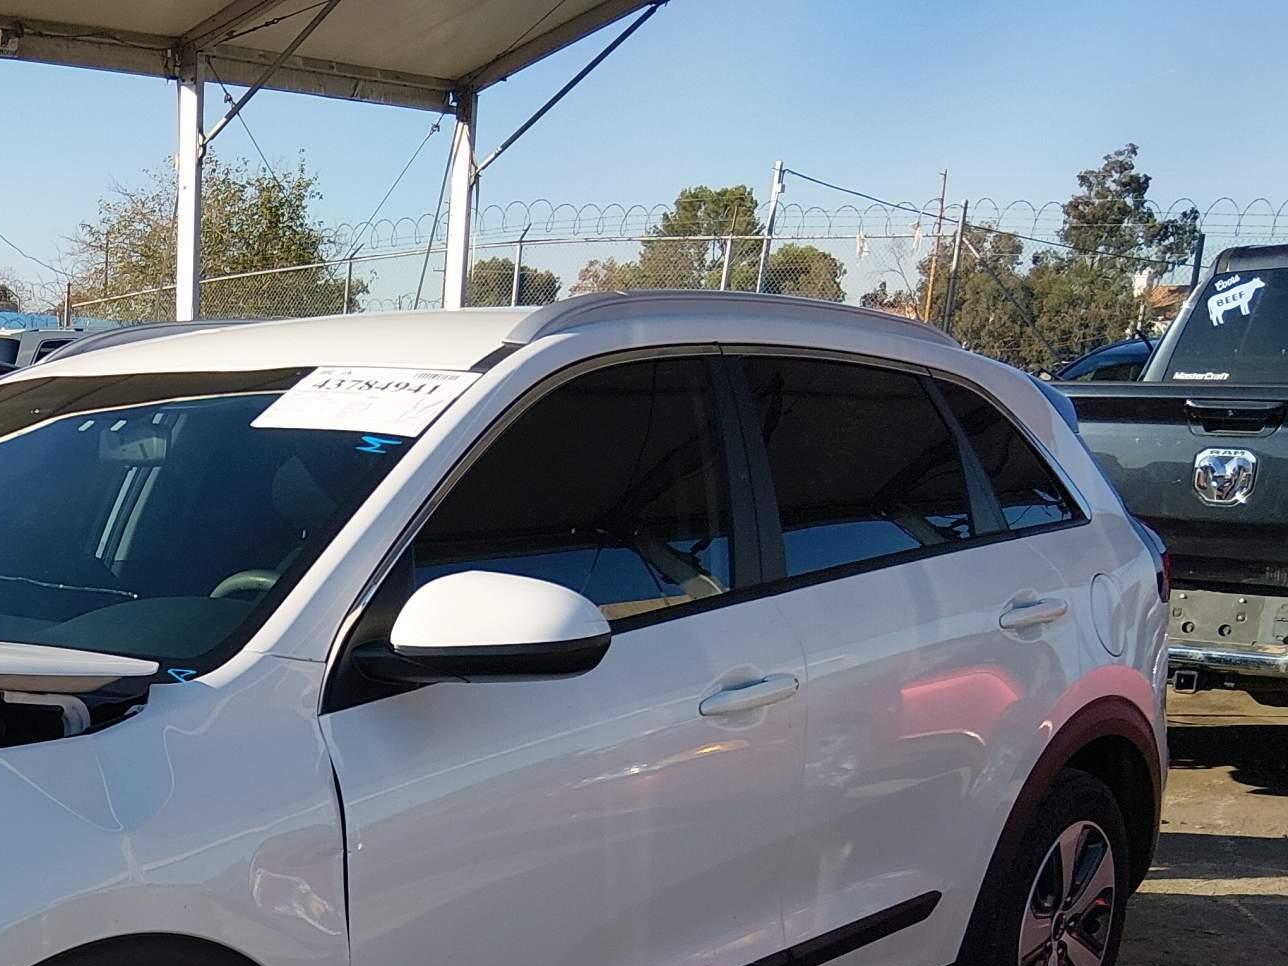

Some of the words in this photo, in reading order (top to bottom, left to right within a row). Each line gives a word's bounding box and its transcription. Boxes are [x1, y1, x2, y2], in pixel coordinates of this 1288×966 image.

[1216, 290, 1246, 307] BEEF
[312, 377, 441, 396] 43784941
[1209, 449, 1247, 457] RAM
